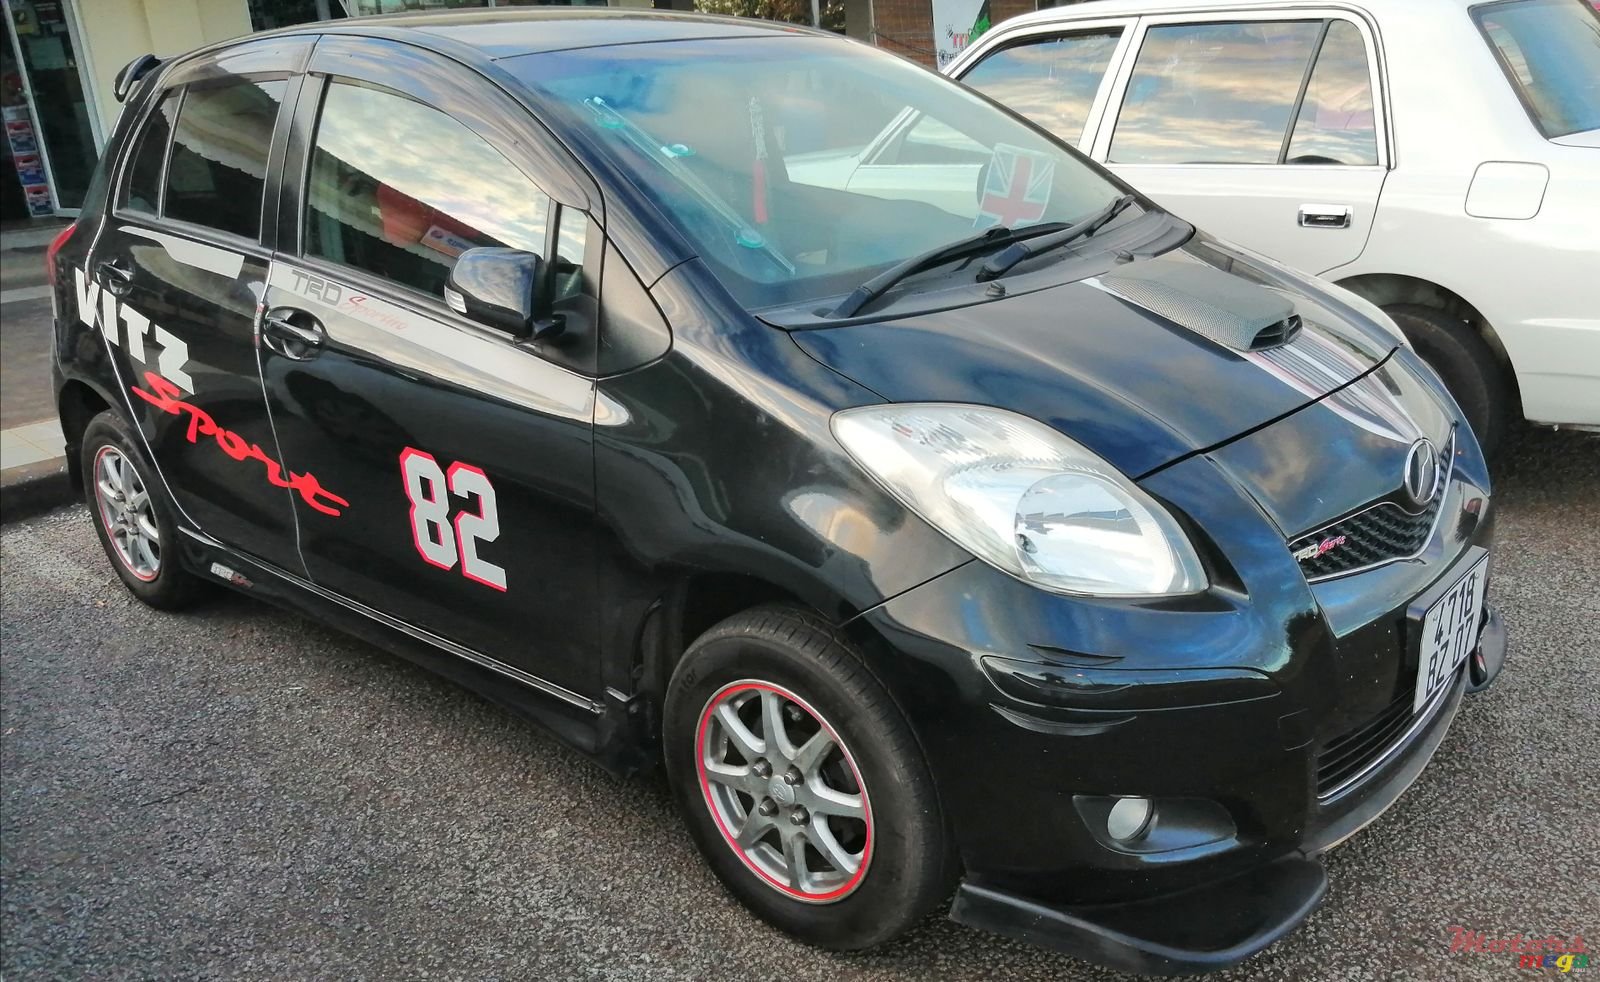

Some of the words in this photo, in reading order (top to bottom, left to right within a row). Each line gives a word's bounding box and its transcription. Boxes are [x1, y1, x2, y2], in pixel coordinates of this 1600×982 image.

[75, 267, 194, 395] VITZ
[292, 269, 342, 306] TRD
[131, 371, 349, 516] Sport
[399, 446, 507, 592] 82
[1426, 638, 1449, 699] BZ
[1452, 612, 1474, 669] 07
[1434, 571, 1475, 646] 4718
